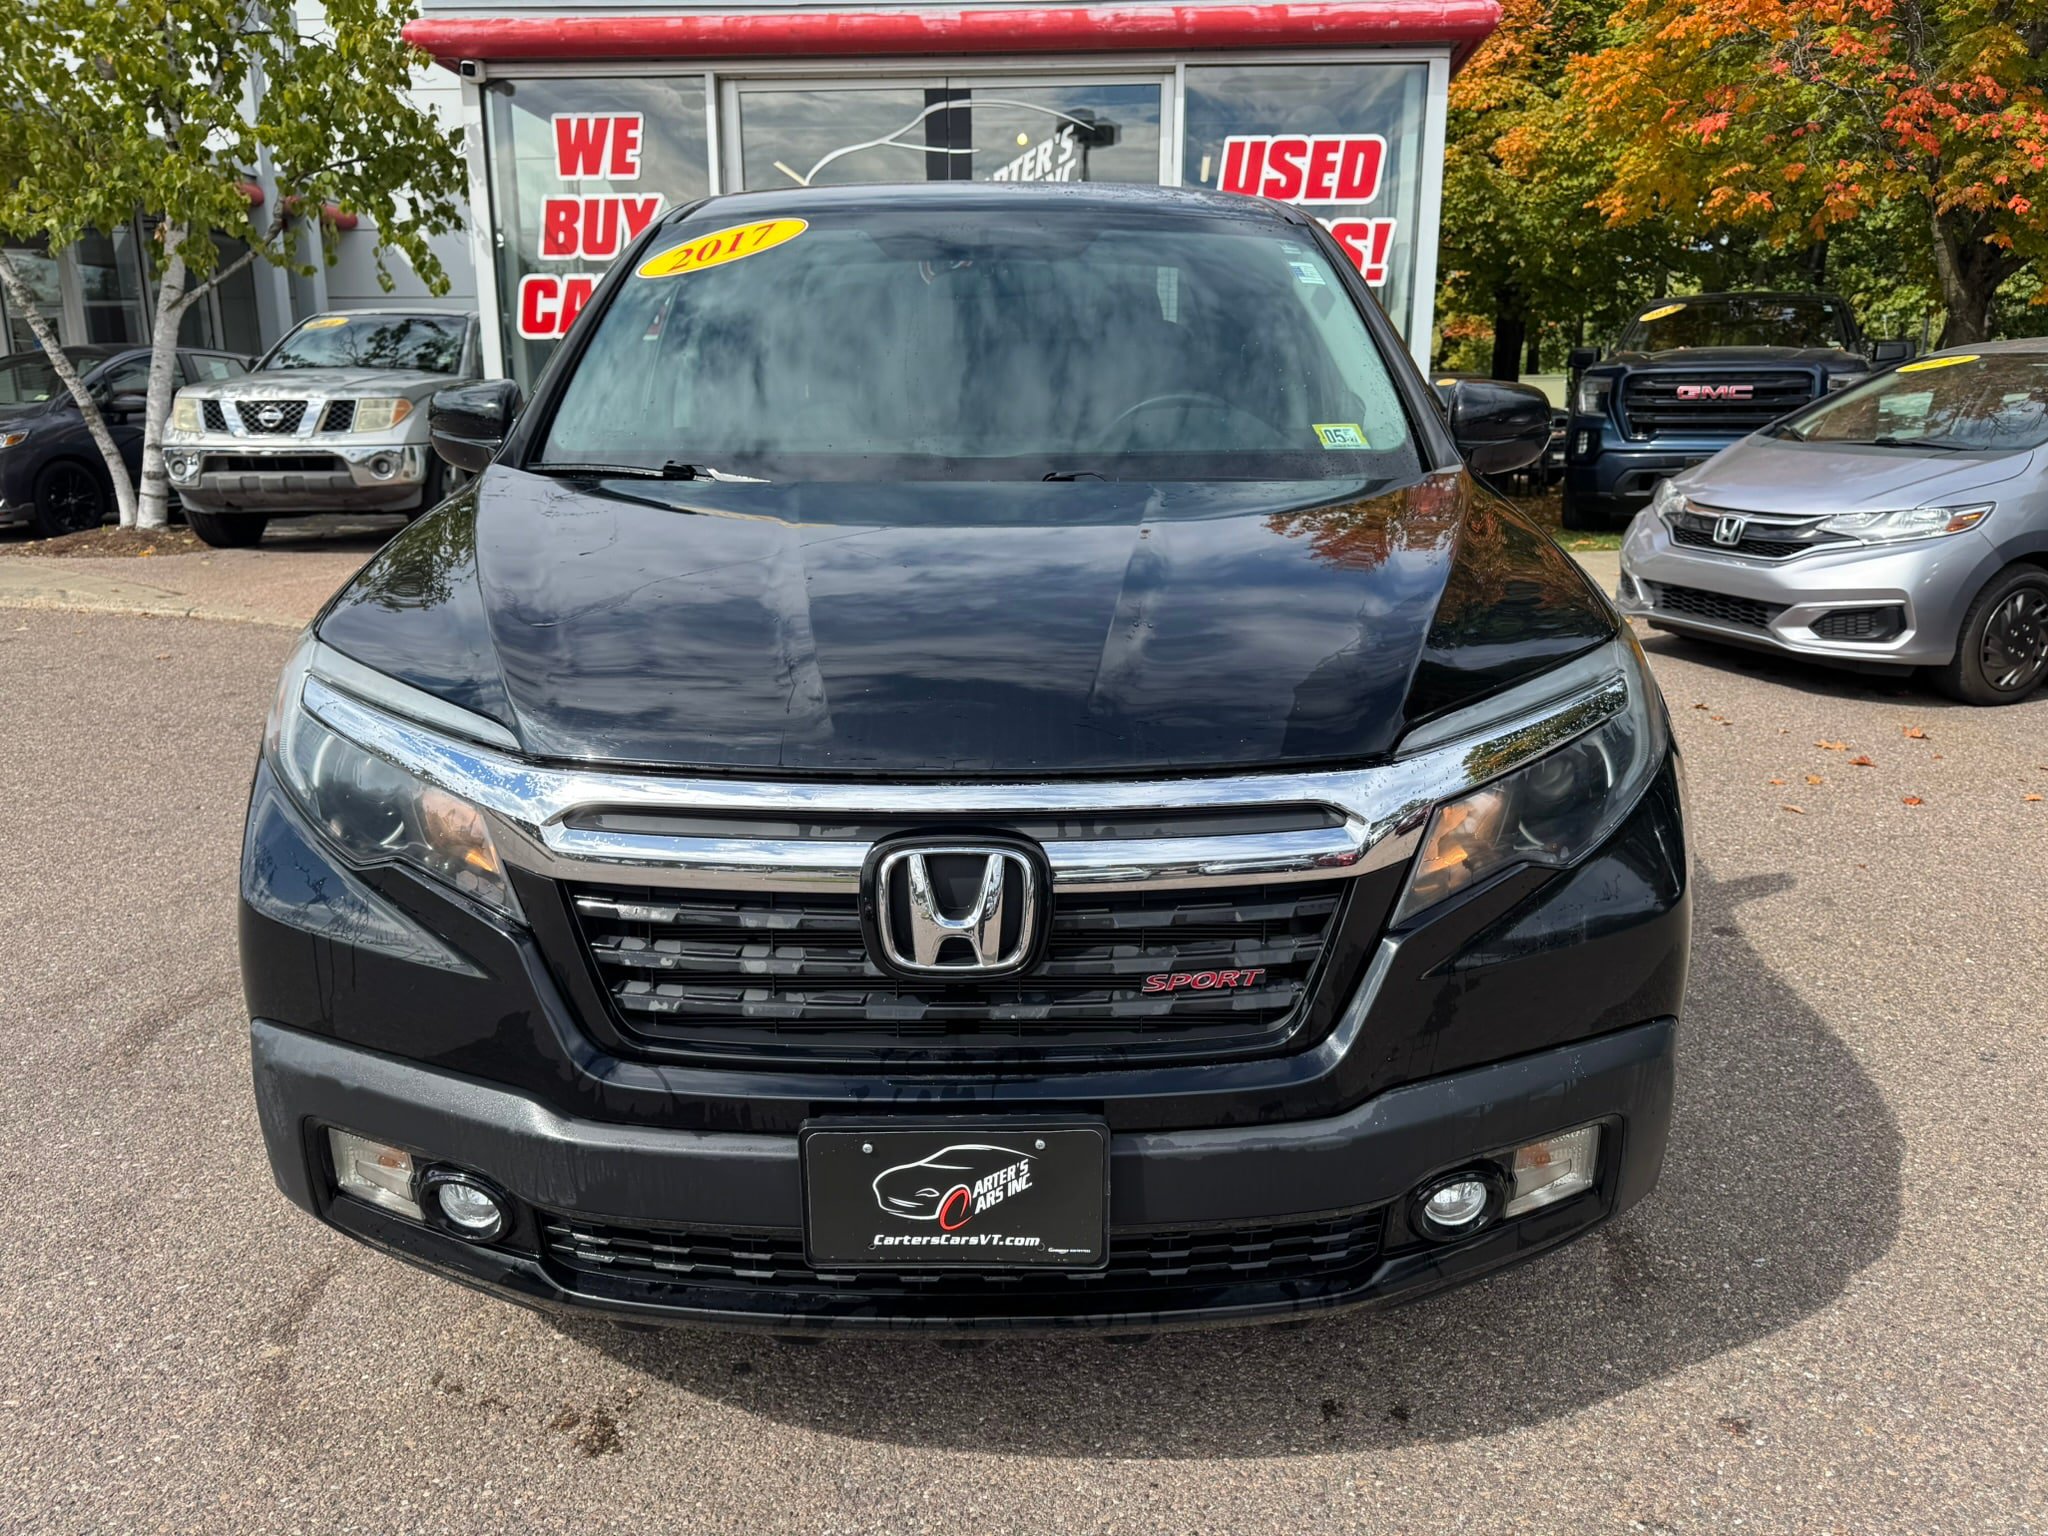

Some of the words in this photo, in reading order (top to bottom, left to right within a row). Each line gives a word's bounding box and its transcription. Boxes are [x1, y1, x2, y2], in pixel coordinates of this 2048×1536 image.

[554, 116, 640, 177] WE
[1222, 139, 1383, 200] USED
[542, 197, 661, 256] BUY
[667, 222, 777, 272] 2017
[521, 277, 598, 335] CA
[1676, 384, 1755, 400] GMC
[1323, 428, 1347, 444] 05
[1141, 968, 1266, 993] SPORT
[872, 1233, 1041, 1247] CartersCarsVT.com
